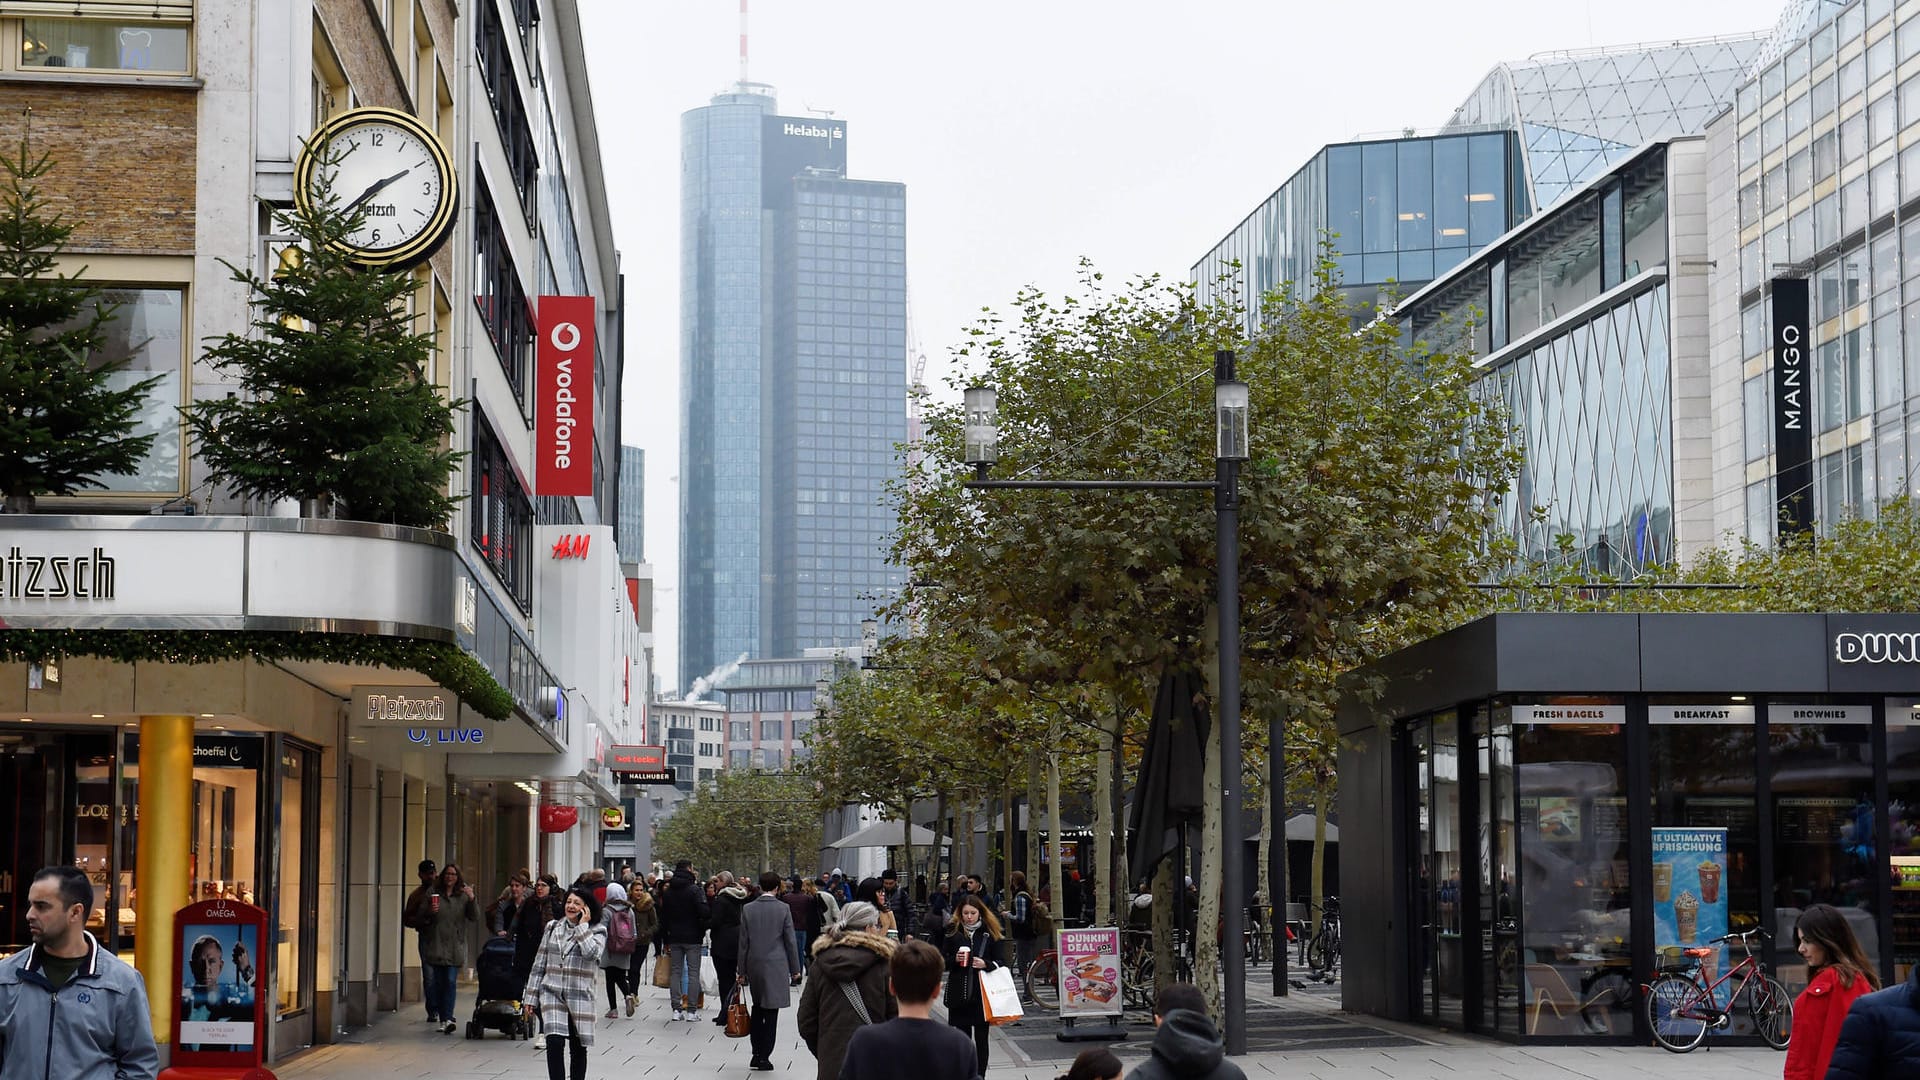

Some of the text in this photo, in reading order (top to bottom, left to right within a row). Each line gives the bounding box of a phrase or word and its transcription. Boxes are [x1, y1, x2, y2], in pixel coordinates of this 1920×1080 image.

[784, 123, 828, 137] Helaba
[372, 133, 383, 147] 12
[423, 182, 431, 195] 3
[371, 229, 381, 242] 6
[1782, 325, 1801, 429] MANGO
[555, 358, 577, 469] vodafone
[552, 534, 591, 560] H&M
[0, 547, 115, 599] tzsch
[1836, 632, 1920, 663] DUN
[367, 694, 445, 720] Pletzsch
[1533, 710, 1604, 719] FRESH BAGELS
[1673, 710, 1730, 719] BREAKFAST
[1793, 710, 1846, 719] BROWNIES
[437, 728, 483, 743] Live
[1664, 834, 1722, 842] ULTIMATIVE
[206, 909, 236, 918] OMEGA
[1067, 934, 1112, 943] DUNKIN'
[1067, 943, 1095, 952] DEAL
